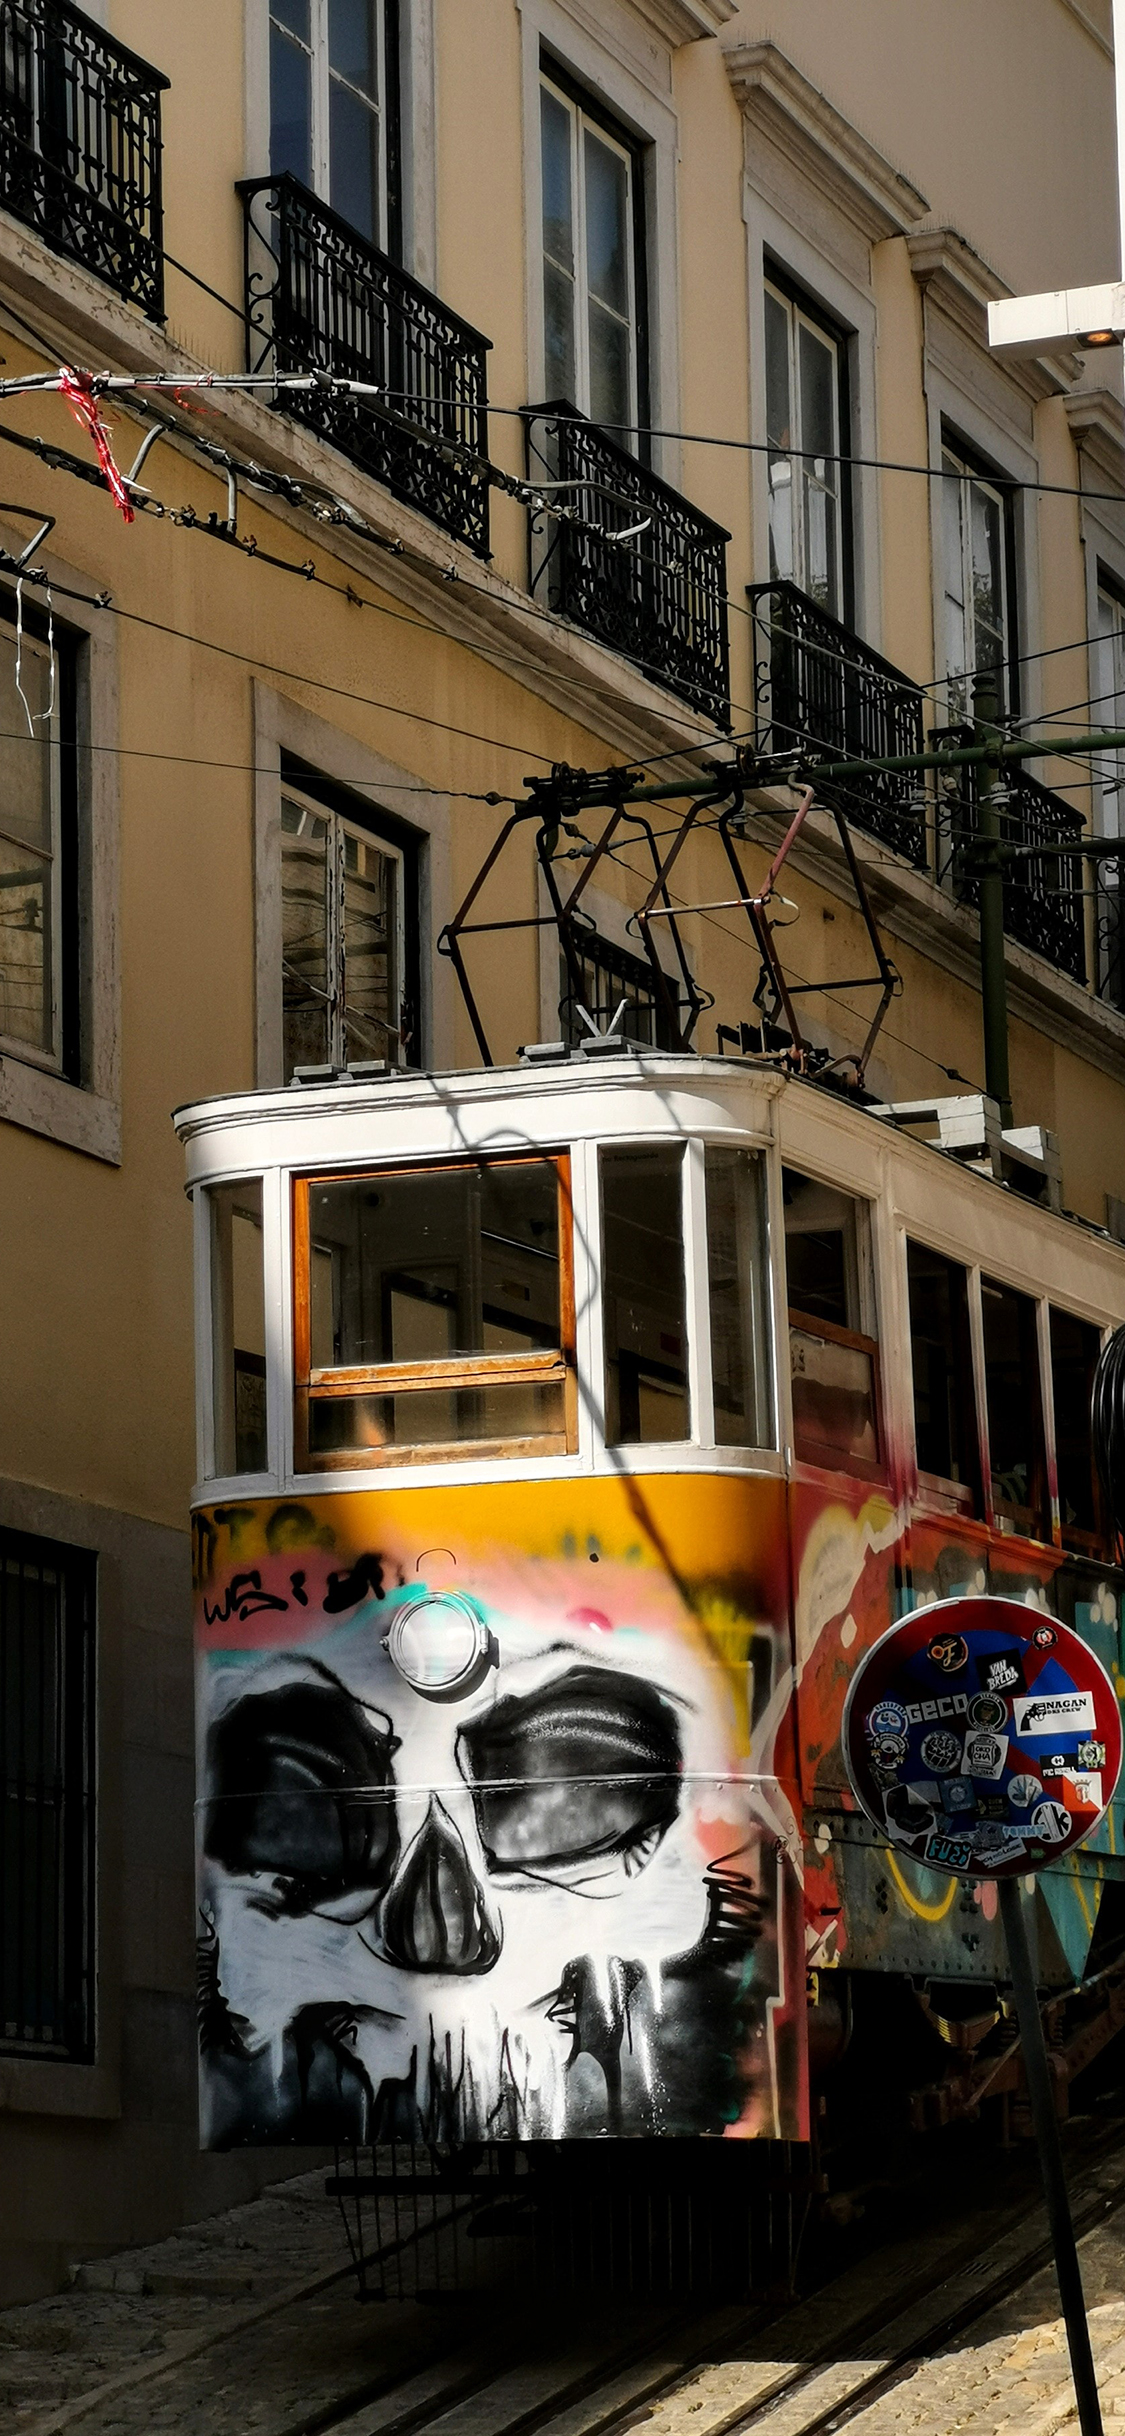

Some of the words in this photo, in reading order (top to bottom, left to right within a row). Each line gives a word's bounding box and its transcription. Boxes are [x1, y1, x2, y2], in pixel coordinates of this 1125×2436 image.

[986, 1666, 1019, 1690] BREDA
[989, 1658, 1007, 1678] VAN
[1046, 1698, 1087, 1709] NAGAN
